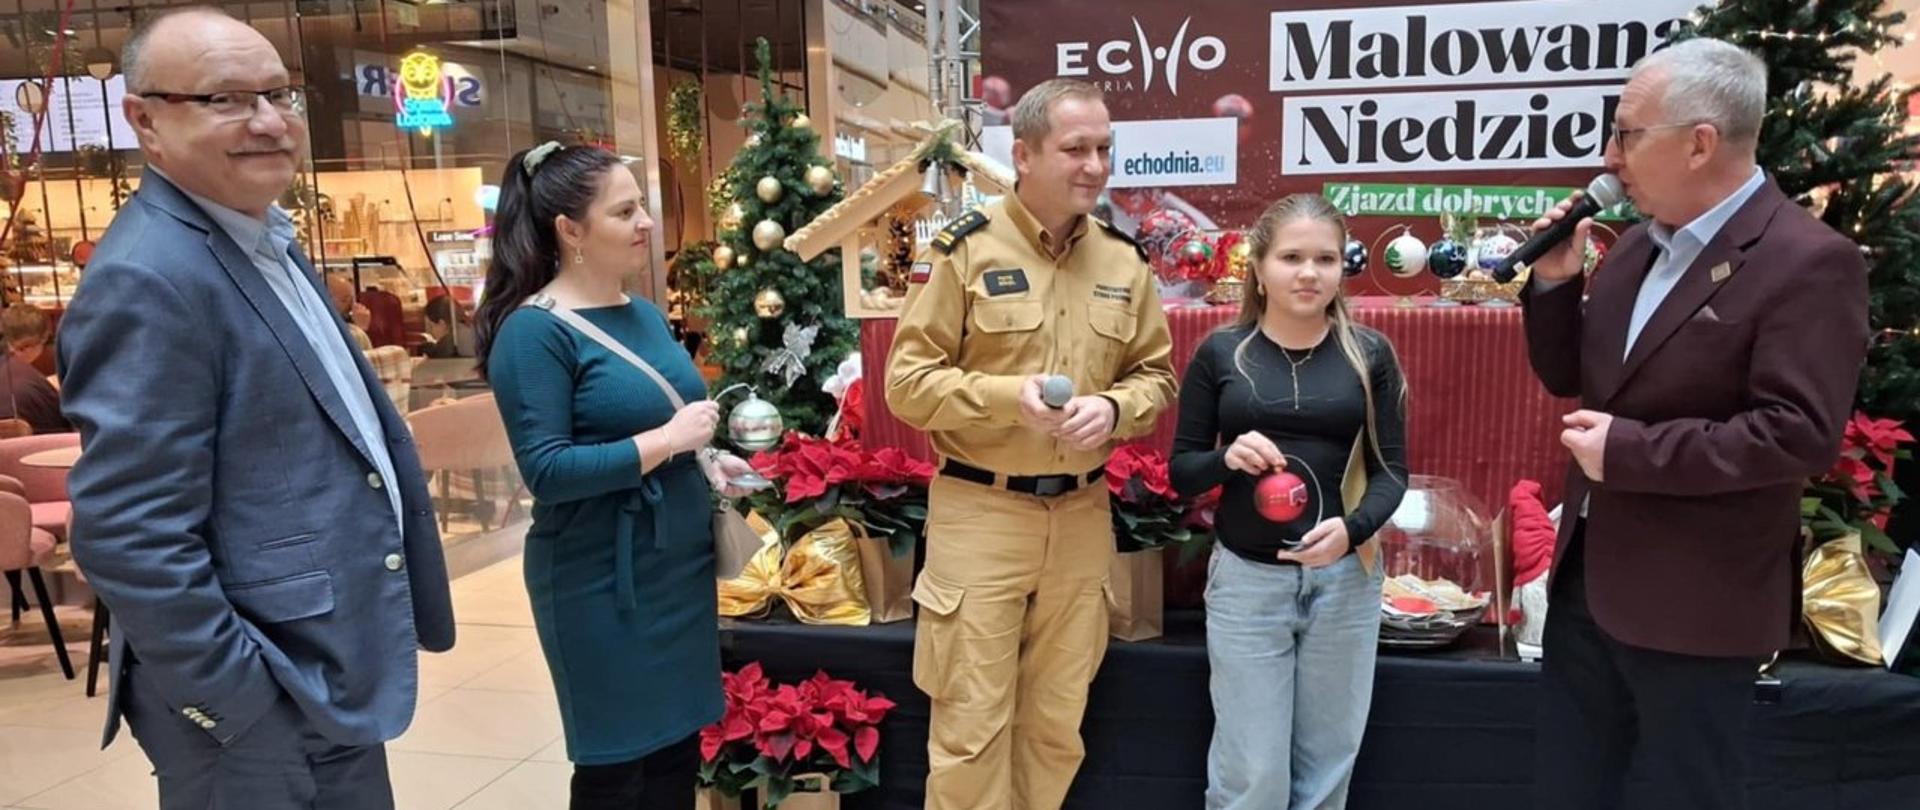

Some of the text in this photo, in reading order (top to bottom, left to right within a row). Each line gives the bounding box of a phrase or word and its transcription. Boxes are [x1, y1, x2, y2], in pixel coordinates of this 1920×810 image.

[1056, 16, 1226, 96] ECHO
[1298, 94, 1621, 166] Niedziel
[1124, 150, 1225, 175] echodnia.eu
[1329, 185, 1555, 220] Zjazd dobrych
